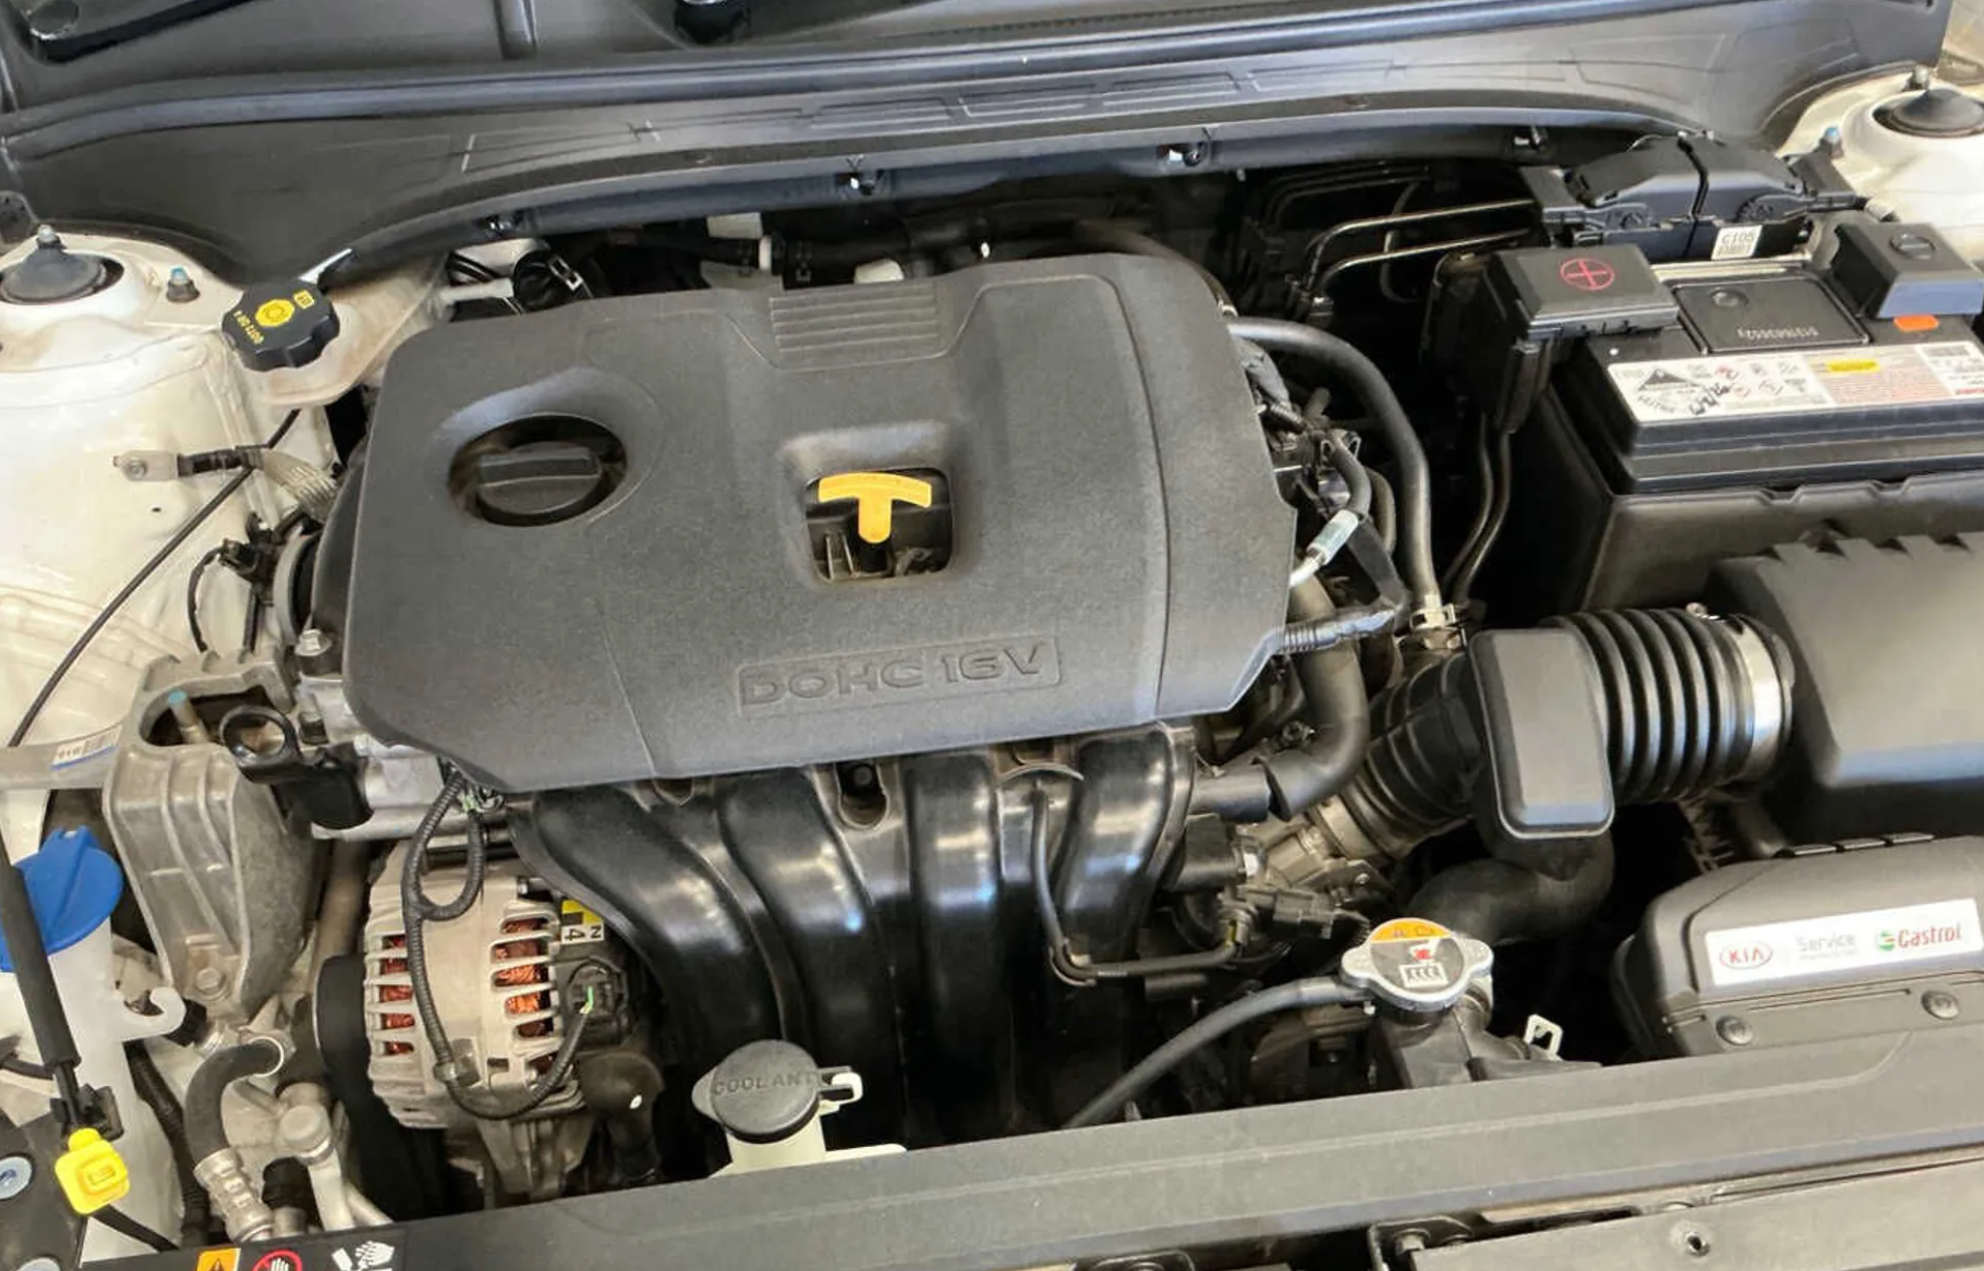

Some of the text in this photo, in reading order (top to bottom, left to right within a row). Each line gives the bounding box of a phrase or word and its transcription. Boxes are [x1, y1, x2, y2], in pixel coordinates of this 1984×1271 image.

[740, 645, 1045, 705] DOHC 16V
[1795, 933, 1857, 952] Service
[1898, 923, 1963, 948] Castrol
[713, 1071, 820, 1096] COOLANT
